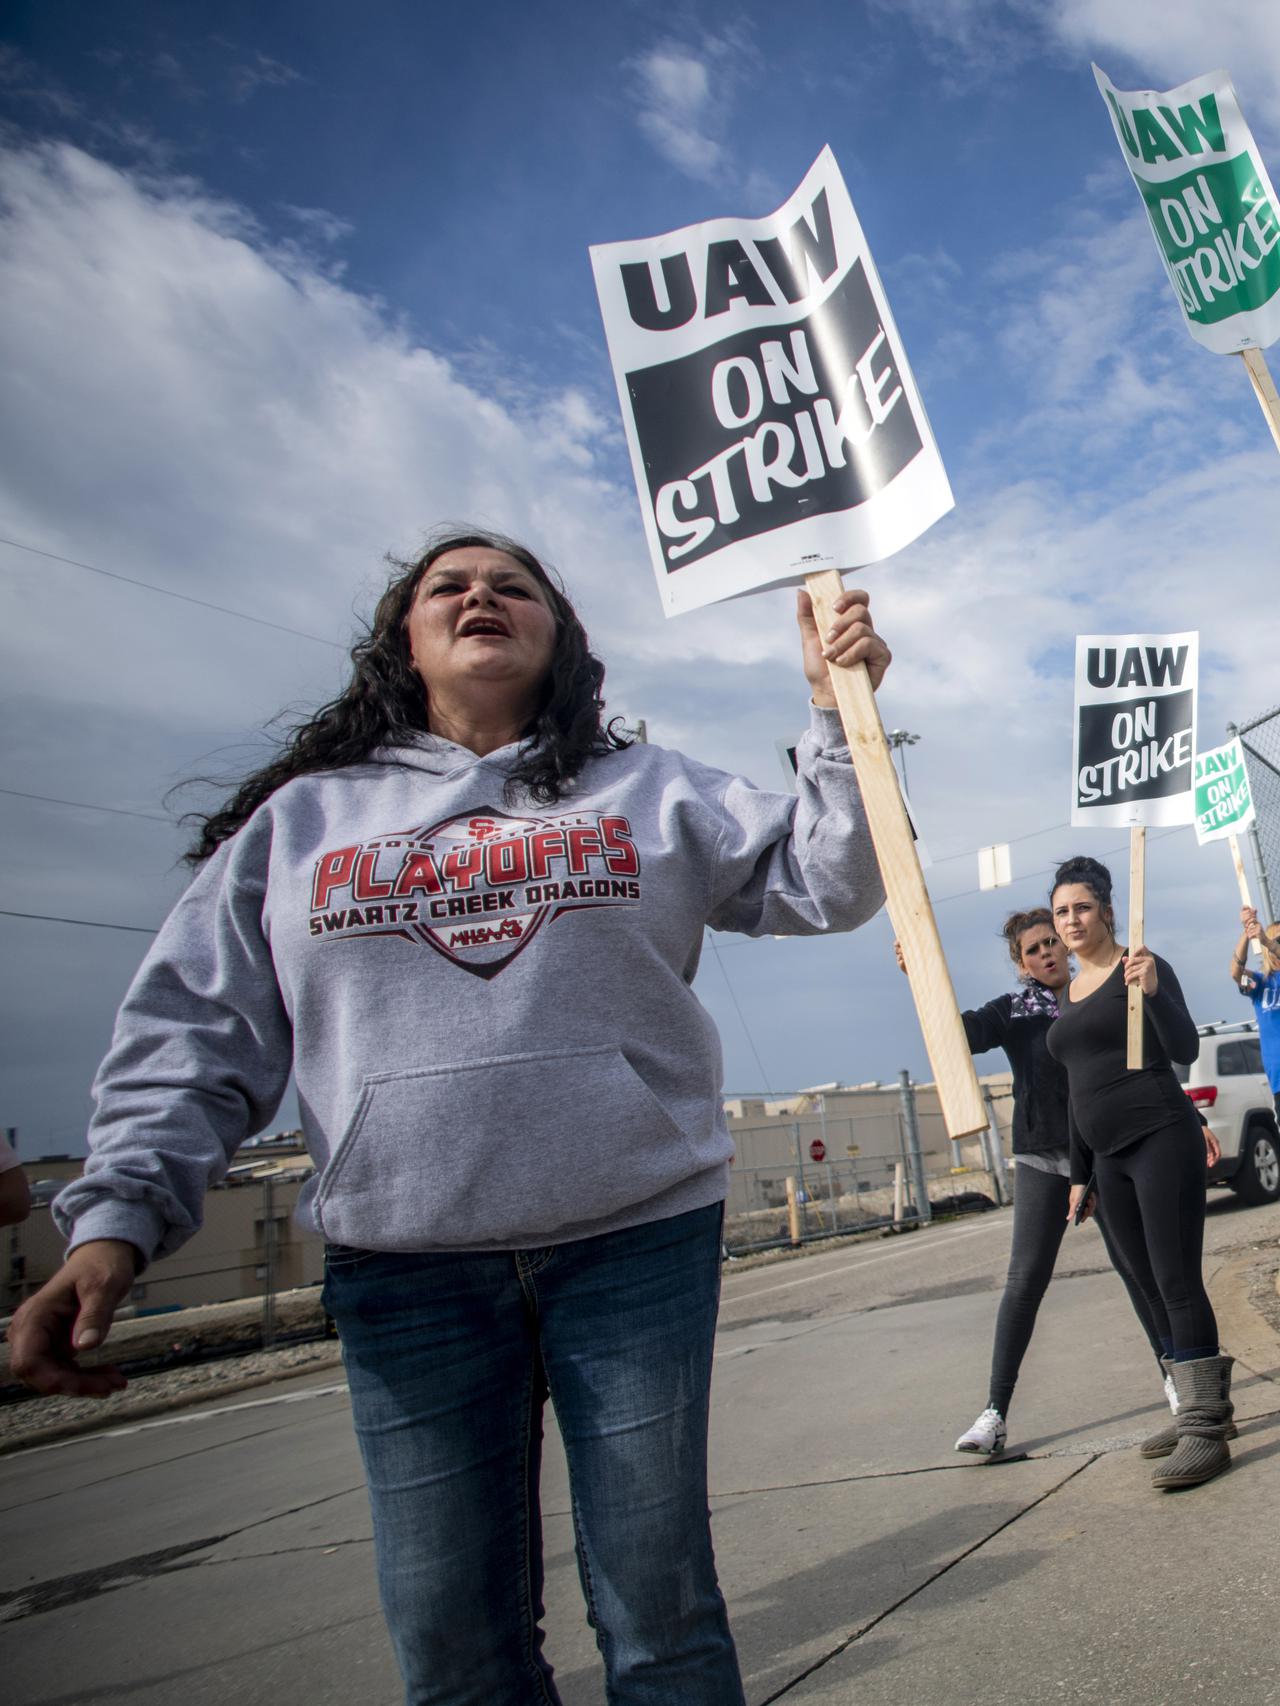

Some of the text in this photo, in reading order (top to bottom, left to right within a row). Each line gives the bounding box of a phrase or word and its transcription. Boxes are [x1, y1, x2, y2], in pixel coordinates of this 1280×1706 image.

[1105, 88, 1226, 164] UAW
[1160, 174, 1222, 248] ON
[620, 185, 838, 331] UAW
[1170, 199, 1280, 312] STRIKE
[711, 329, 819, 429] ON
[655, 325, 902, 560] STRIKE
[1087, 645, 1189, 689] UAW
[1111, 701, 1156, 749] ON
[1078, 728, 1192, 803] STRIKE
[1207, 777, 1232, 804] ON
[1198, 779, 1248, 835] STRIKE
[309, 815, 642, 913] PLAYOFFS
[309, 879, 641, 937] SWARTZ CREEK DRAGONS
